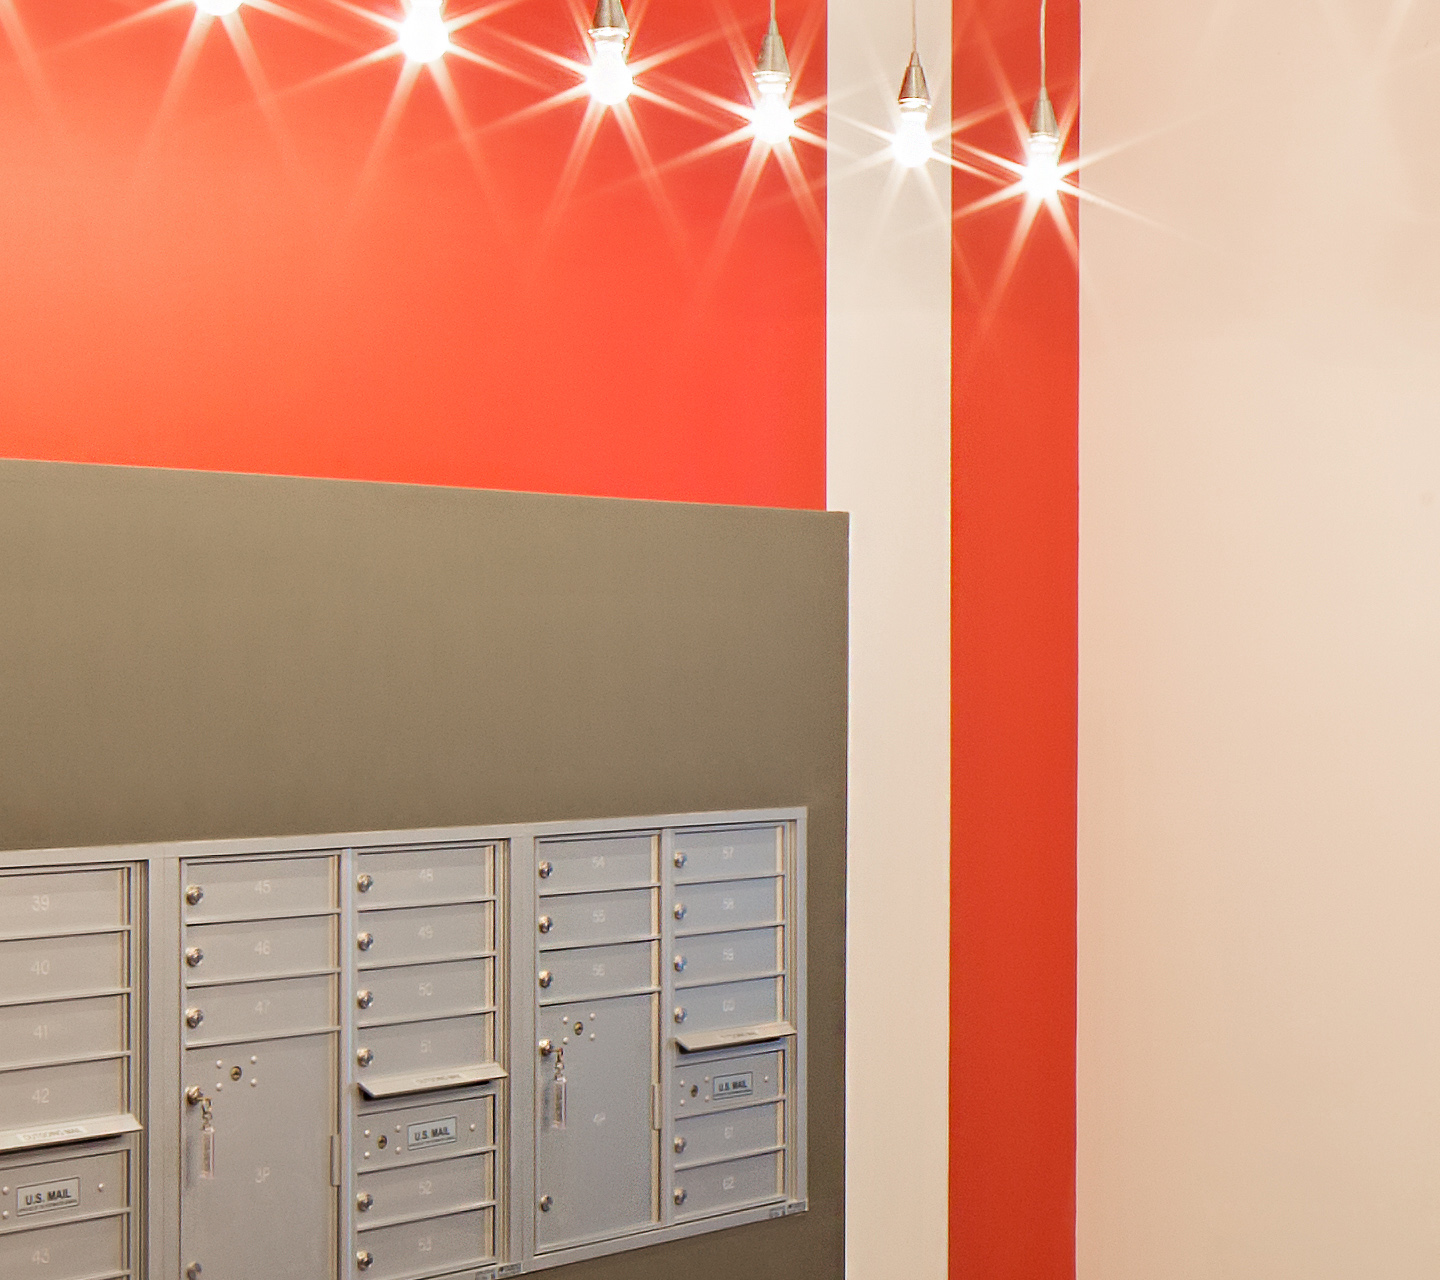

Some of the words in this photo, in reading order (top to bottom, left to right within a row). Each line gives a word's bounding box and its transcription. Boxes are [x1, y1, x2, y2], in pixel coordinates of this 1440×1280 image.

[418, 867, 434, 883] 48
[254, 880, 271, 895] 45
[31, 894, 50, 912] 39
[254, 940, 271, 955] 46
[30, 959, 50, 975] 40
[418, 982, 433, 997] 50
[33, 1024, 48, 1040] 41
[732, 1080, 747, 1090] MAIL
[31, 1087, 50, 1104] 42
[413, 1129, 429, 1141] U.S.
[431, 1126, 450, 1138] MAIL
[25, 1192, 45, 1206] U.S.
[47, 1188, 72, 1202] MAIL
[32, 1247, 51, 1265] 43
